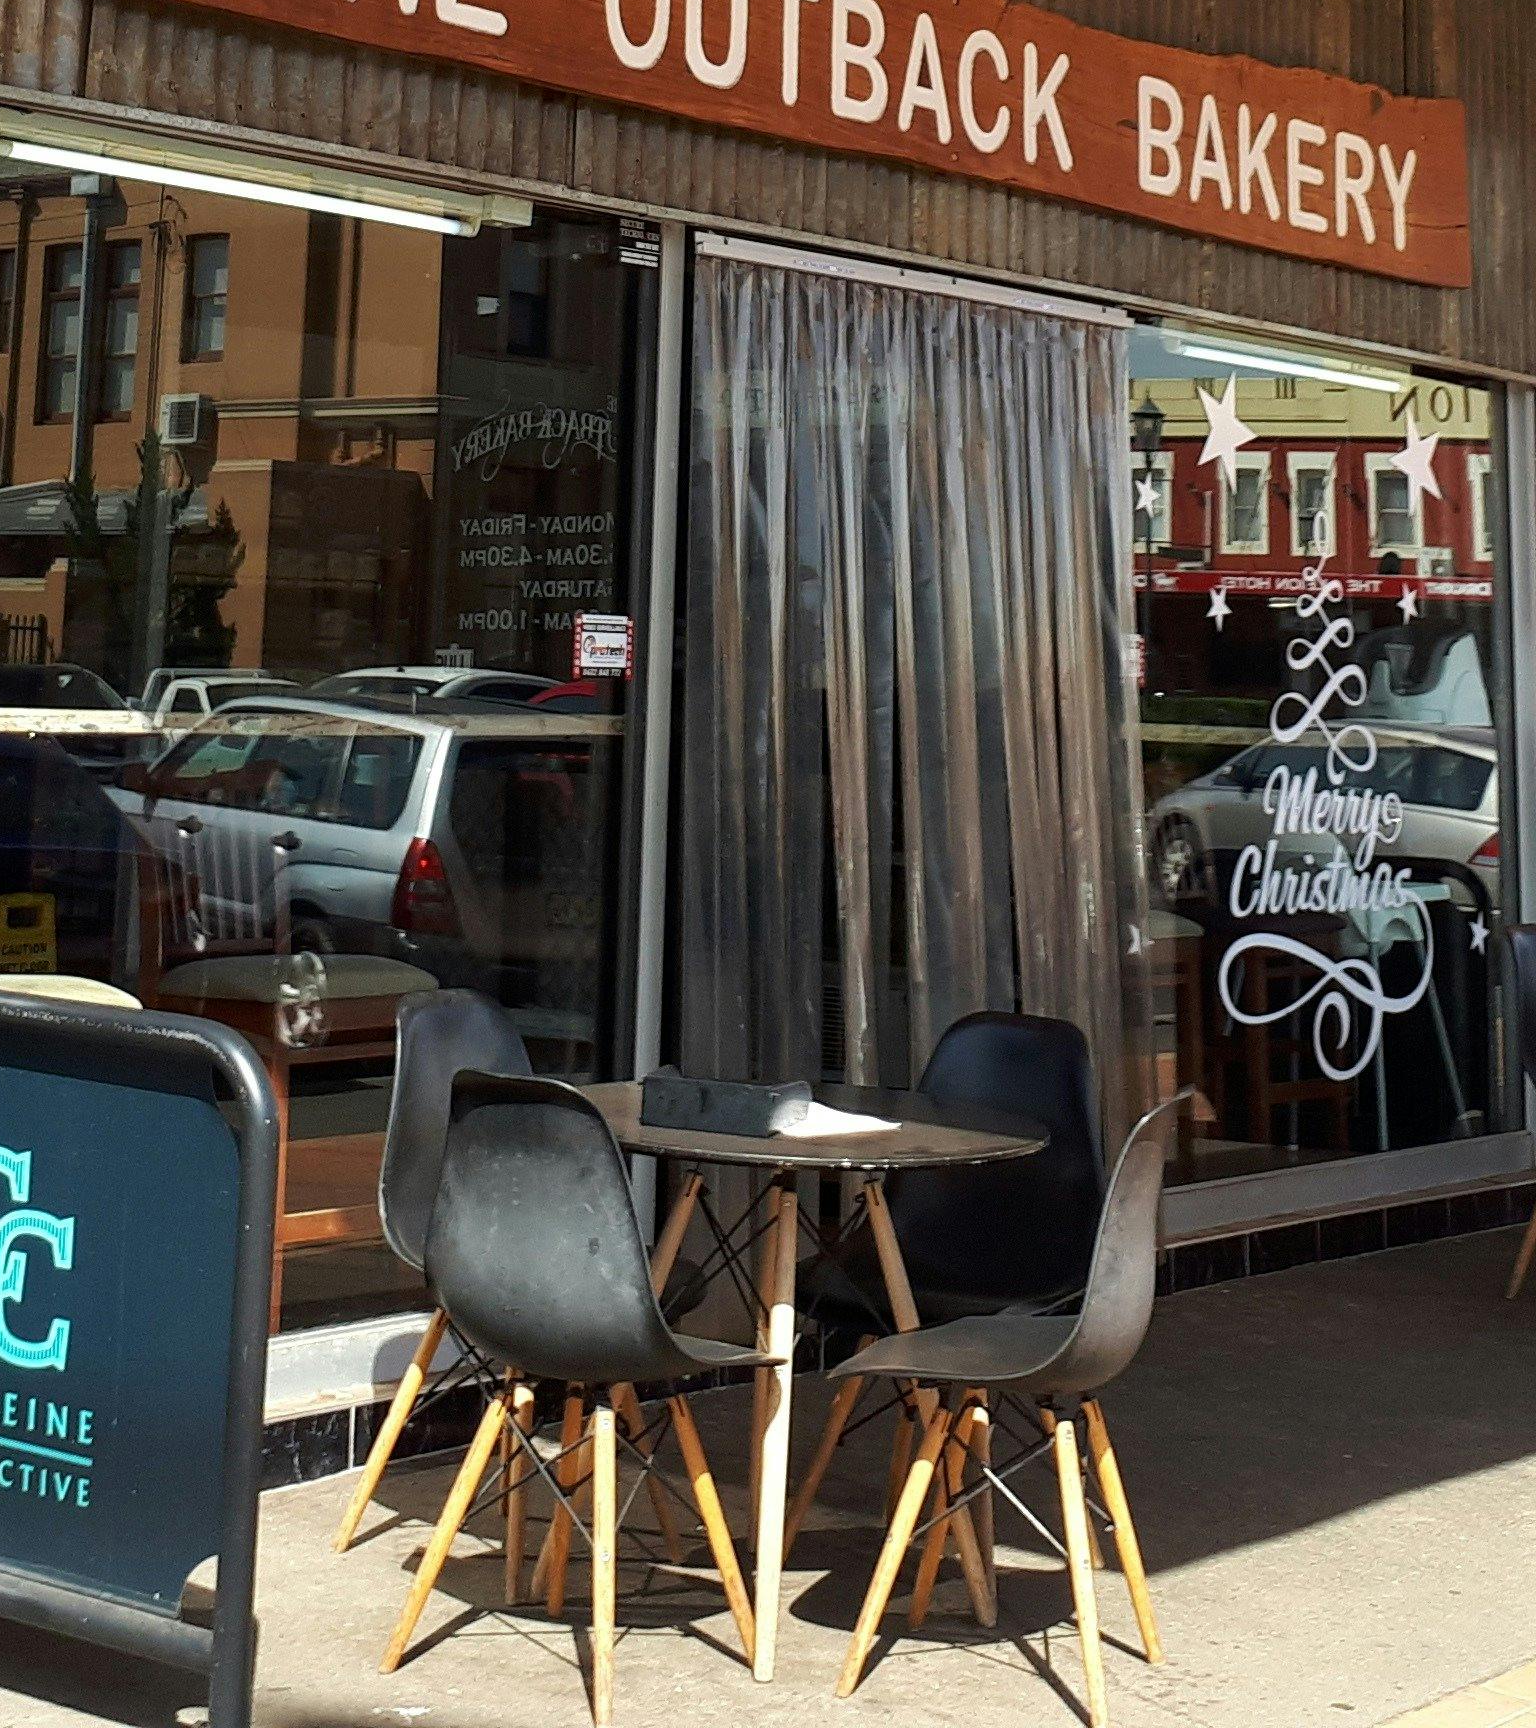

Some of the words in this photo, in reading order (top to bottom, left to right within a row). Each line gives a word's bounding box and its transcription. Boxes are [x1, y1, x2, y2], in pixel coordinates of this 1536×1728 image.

[1134, 76, 1418, 252] BAKERY
[1263, 763, 1402, 869] Merry
[1230, 838, 1414, 920] Christmas
